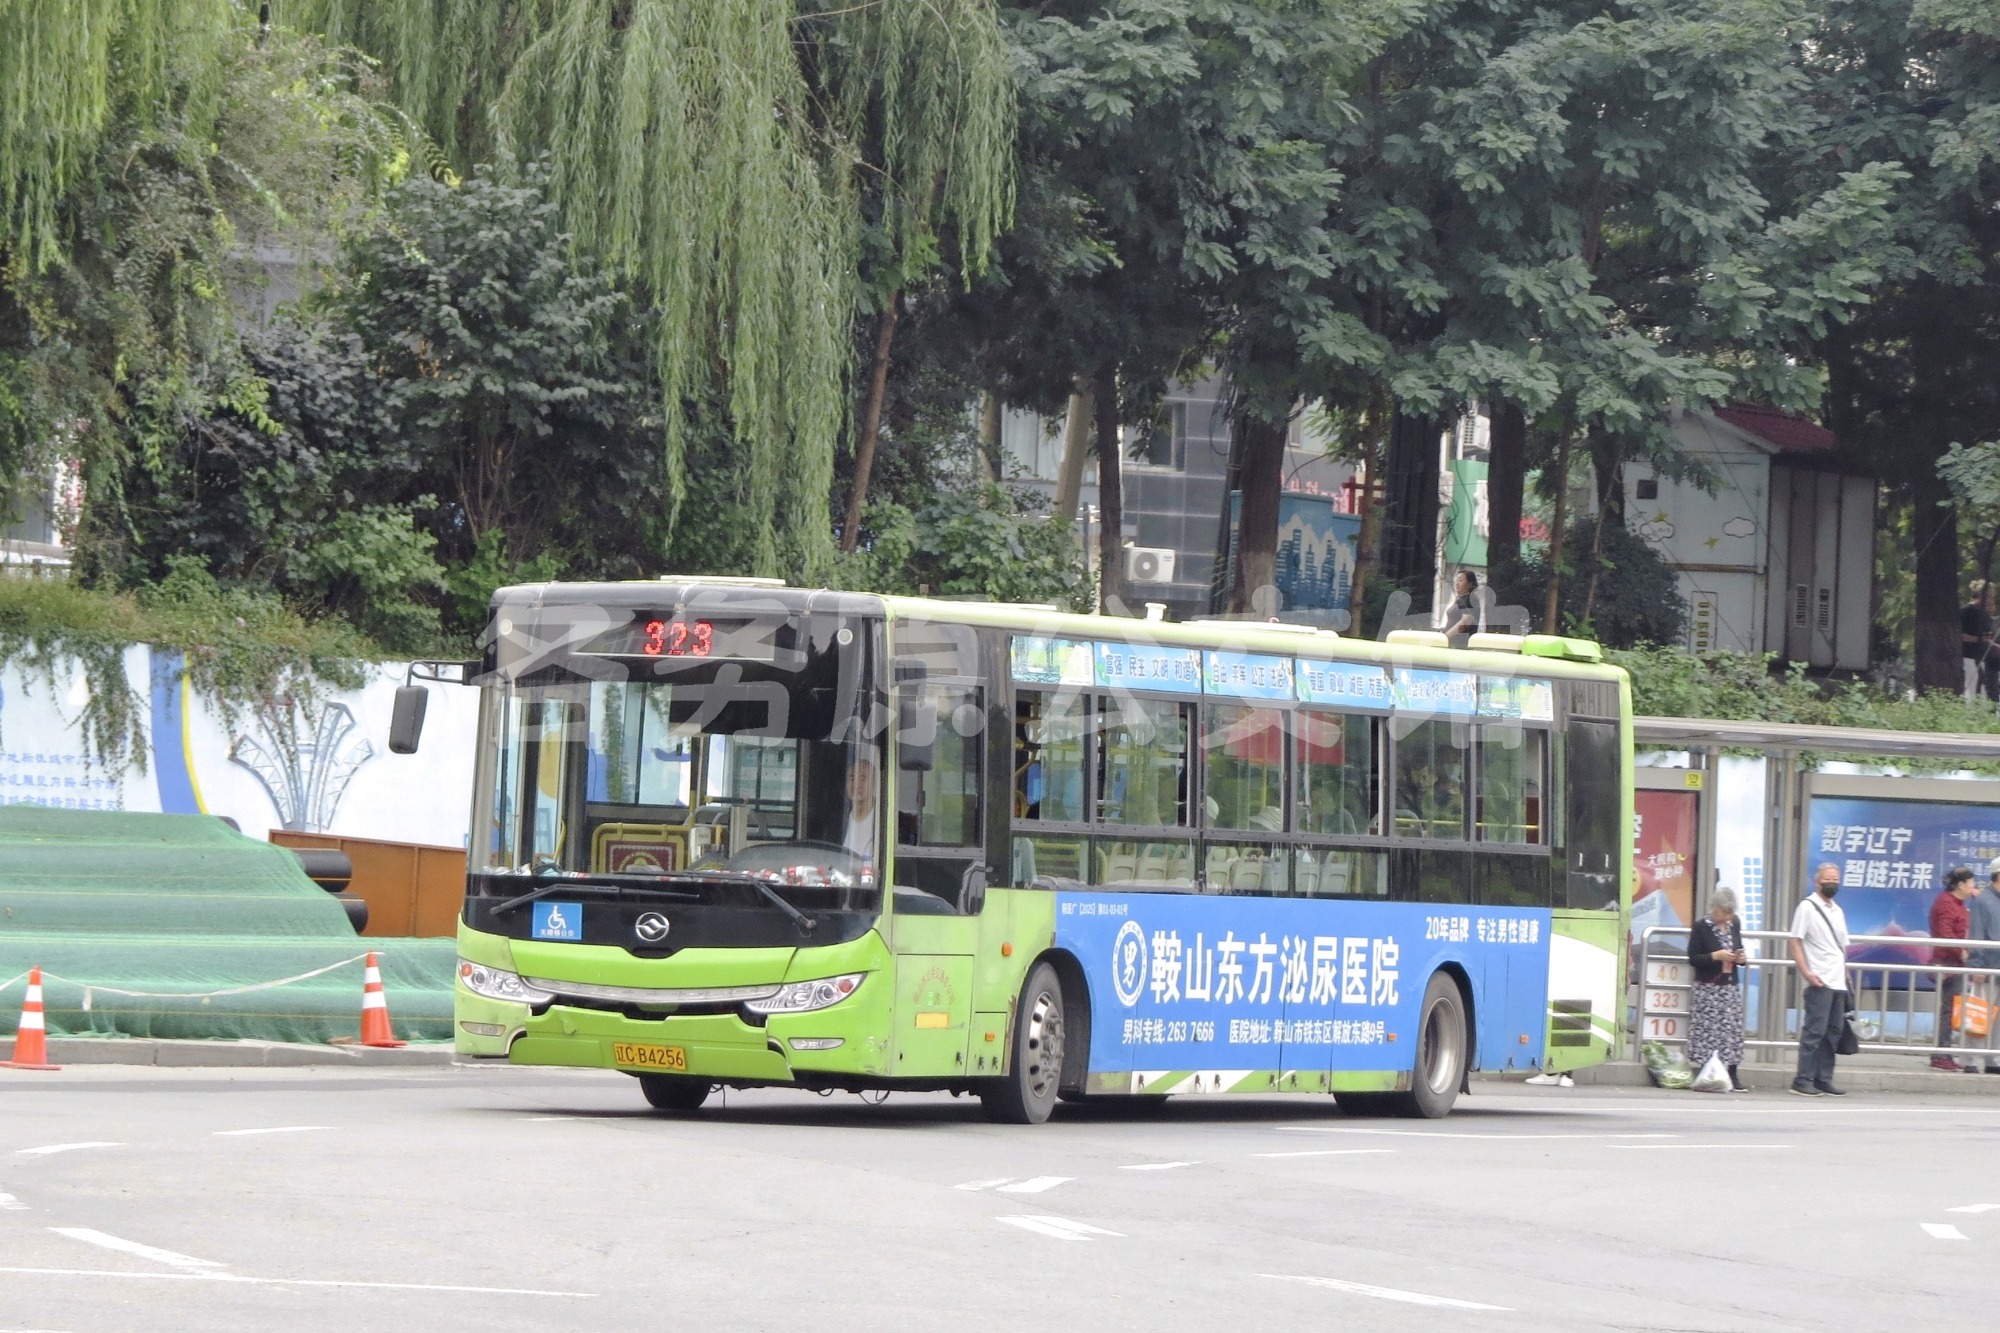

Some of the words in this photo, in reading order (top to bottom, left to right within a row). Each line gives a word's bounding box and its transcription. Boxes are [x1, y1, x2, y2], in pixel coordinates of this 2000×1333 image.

[645, 620, 713, 656] 323
[1104, 653, 1123, 676] 富强
[1129, 656, 1146, 678] 民主
[1151, 657, 1169, 680] 文明
[1213, 663, 1228, 684] 自由
[1232, 664, 1247, 685] 平等
[1251, 666, 1265, 687] 公正
[1310, 671, 1325, 693] 爱国
[1329, 672, 1344, 694] 敬业
[1350, 673, 1364, 696] 诚信
[1368, 675, 1383, 698] 友善
[1820, 824, 1913, 855] 数字辽宁
[1425, 916, 1470, 943] 20年品牌
[1476, 917, 1539, 944] 专注男性健康
[1150, 929, 1399, 1006] 鞍山东方泌尿医院
[1658, 965, 1678, 981] 40
[1653, 992, 1680, 1008] 323
[1651, 1018, 1677, 1036] 10
